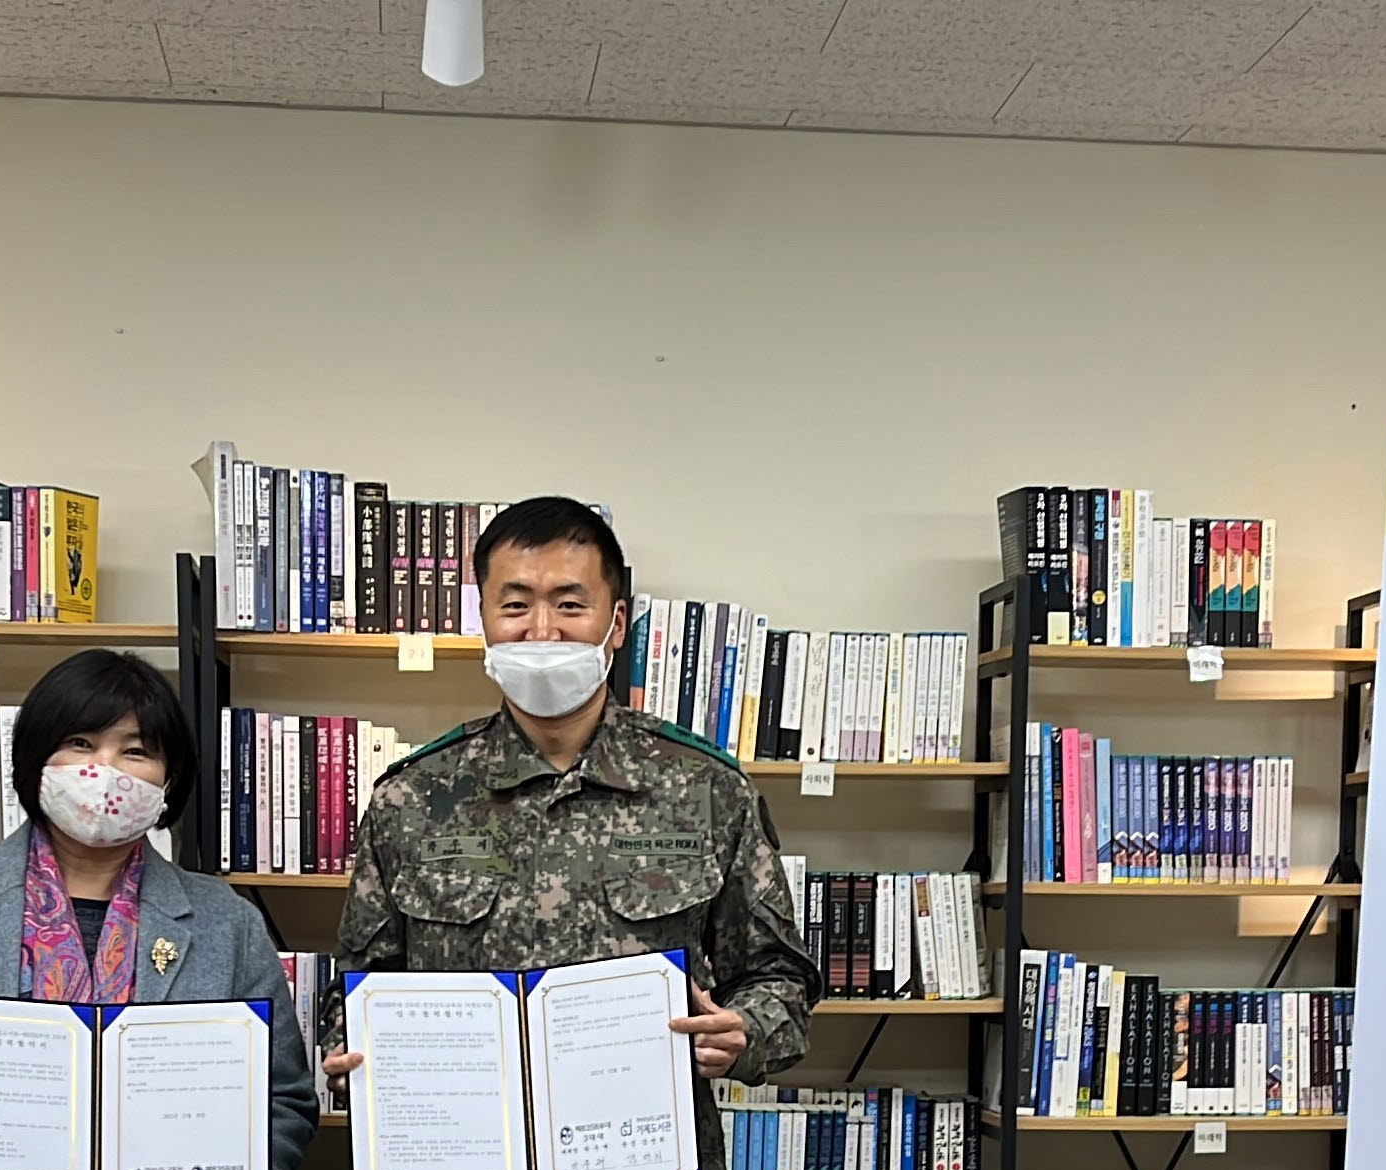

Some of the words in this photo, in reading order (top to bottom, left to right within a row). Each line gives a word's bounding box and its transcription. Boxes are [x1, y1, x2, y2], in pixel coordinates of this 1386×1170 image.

[396, 508, 406, 536] 예정된
[421, 508, 431, 536] 예정된
[445, 508, 454, 536] 예정된
[397, 537, 406, 556] 전쟁
[422, 537, 431, 556] 전쟁
[446, 537, 454, 556] 전쟁
[653, 630, 662, 659] JUSTICE
[805, 774, 832, 785] 사회학
[615, 839, 652, 850] 대한민국
[655, 839, 673, 849] 육군
[1023, 968, 1038, 1031] 대항해시대
[1128, 982, 1137, 1074] EXHALATION
[1144, 982, 1152, 1075] EXHALATION
[1163, 992, 1171, 1086] EXHALATION
